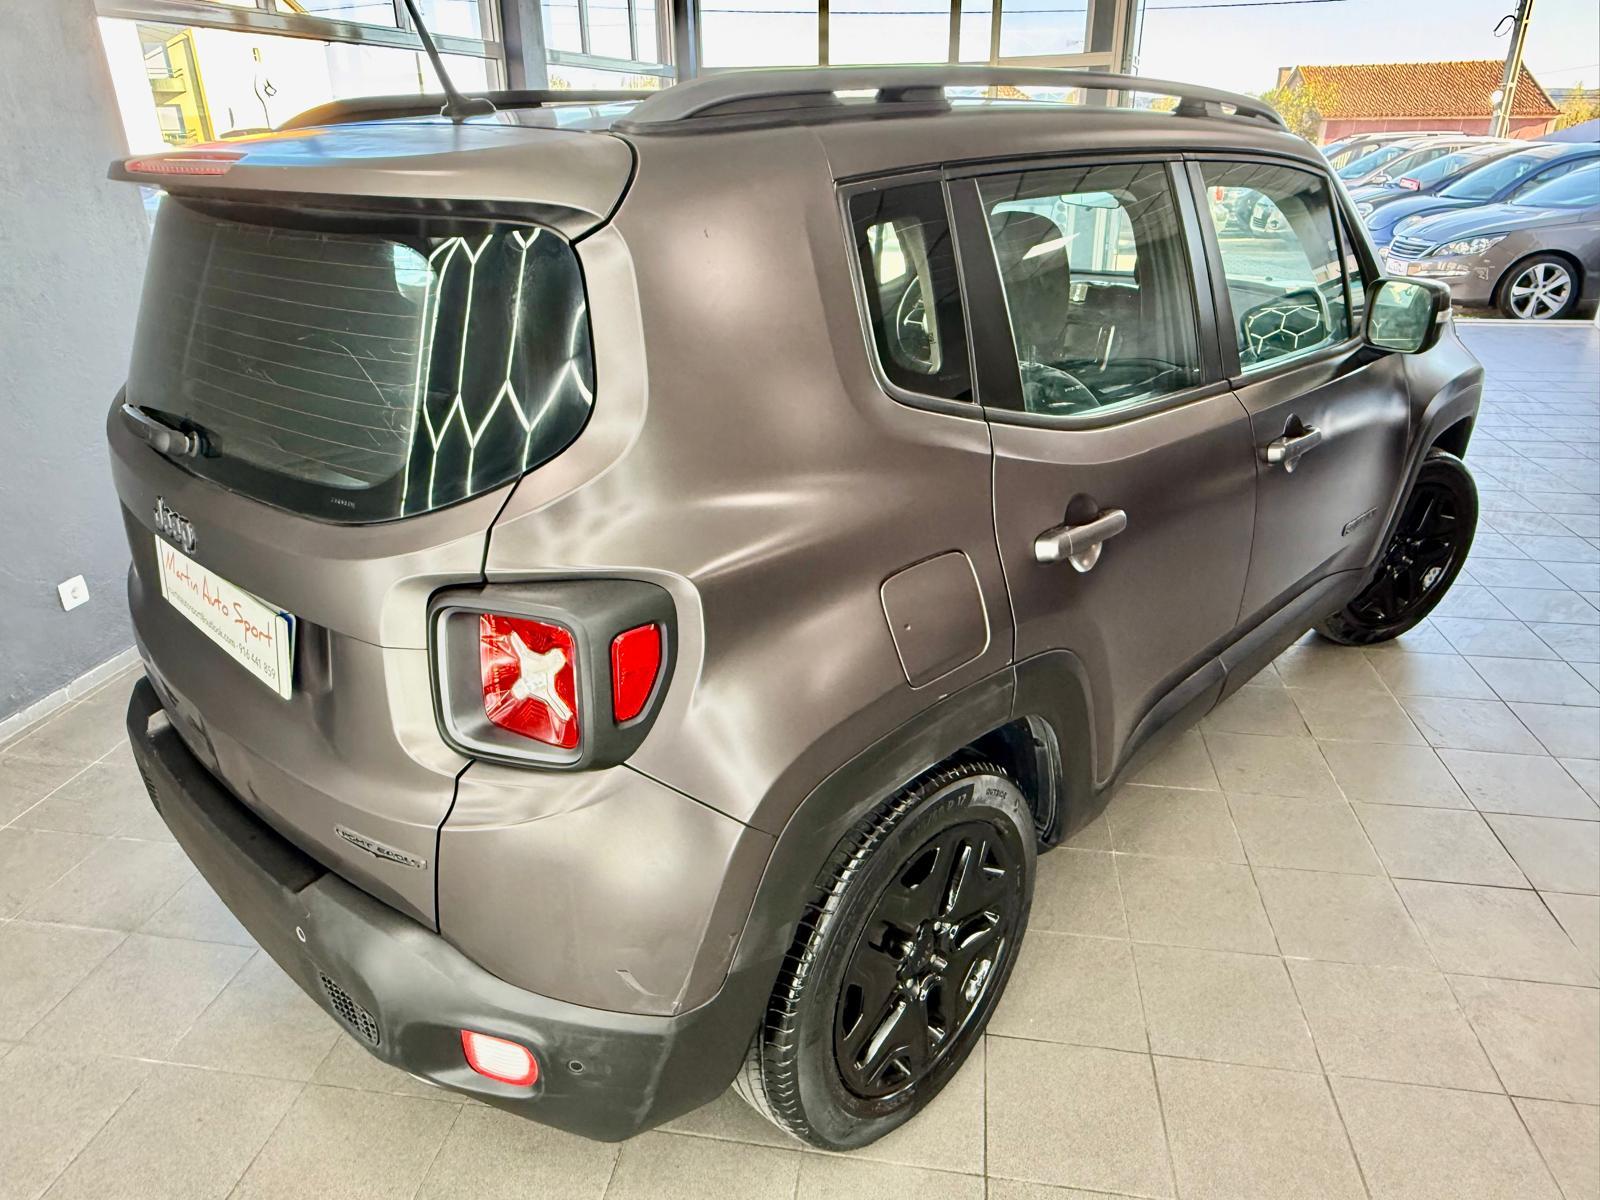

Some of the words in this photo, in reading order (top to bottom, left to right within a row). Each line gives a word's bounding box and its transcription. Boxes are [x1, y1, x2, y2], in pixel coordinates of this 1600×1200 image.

[154, 495, 197, 554] Jeep
[165, 551, 199, 593] Martin
[202, 575, 229, 617] Auto
[232, 602, 273, 648] Sport
